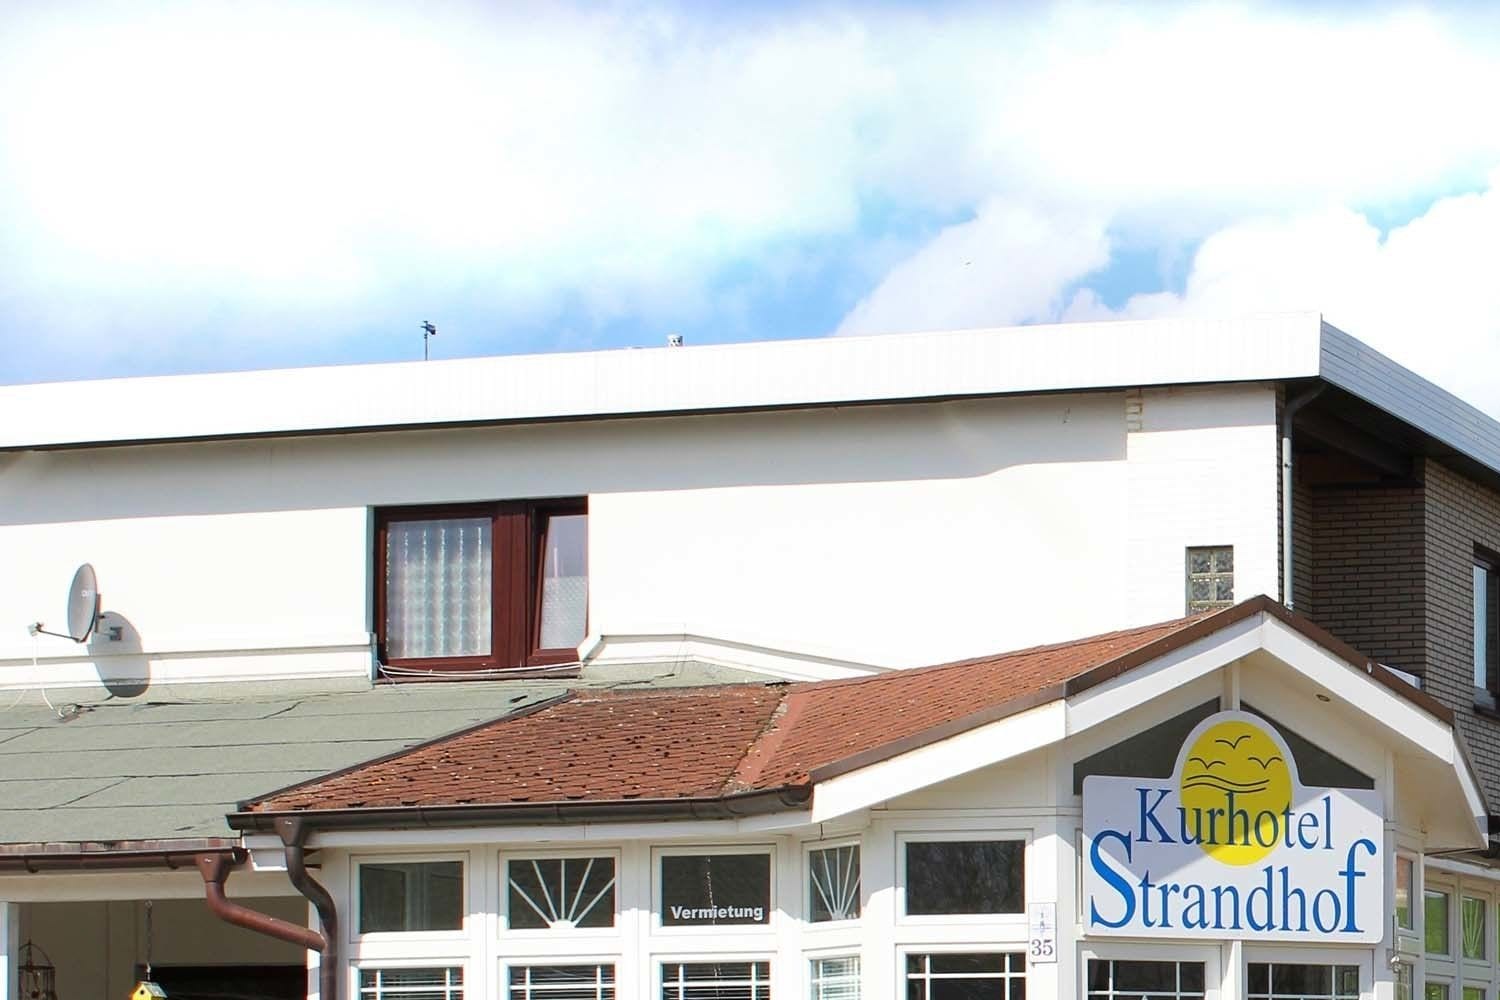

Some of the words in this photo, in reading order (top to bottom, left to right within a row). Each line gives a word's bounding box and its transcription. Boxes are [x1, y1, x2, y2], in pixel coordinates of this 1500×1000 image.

[1135, 787, 1336, 851] Kurhotel
[1089, 828, 1378, 934] Strandhof
[670, 905, 764, 921] Vermietung
[1031, 938, 1054, 957] 35
